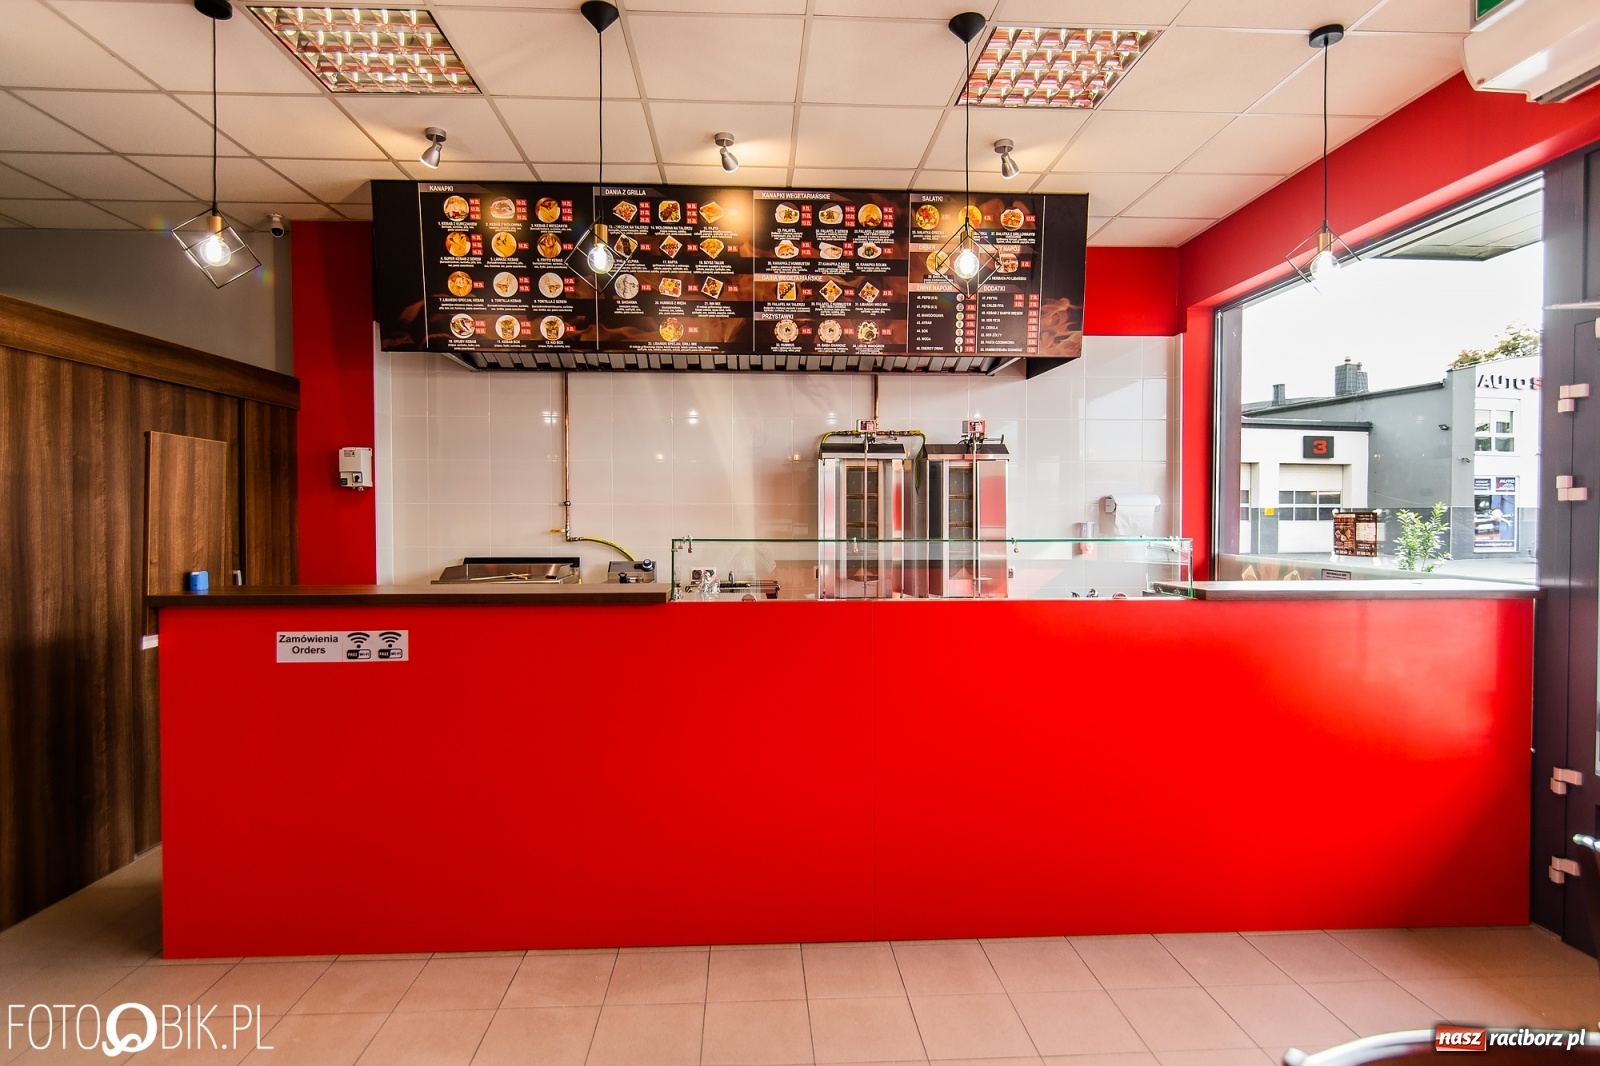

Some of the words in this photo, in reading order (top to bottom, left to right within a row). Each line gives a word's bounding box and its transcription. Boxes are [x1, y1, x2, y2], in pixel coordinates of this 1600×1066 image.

[1477, 374, 1526, 390] AUTO
[1313, 440, 1327, 454] 3
[279, 634, 338, 643] Zamówienia
[292, 646, 326, 654] Orders
